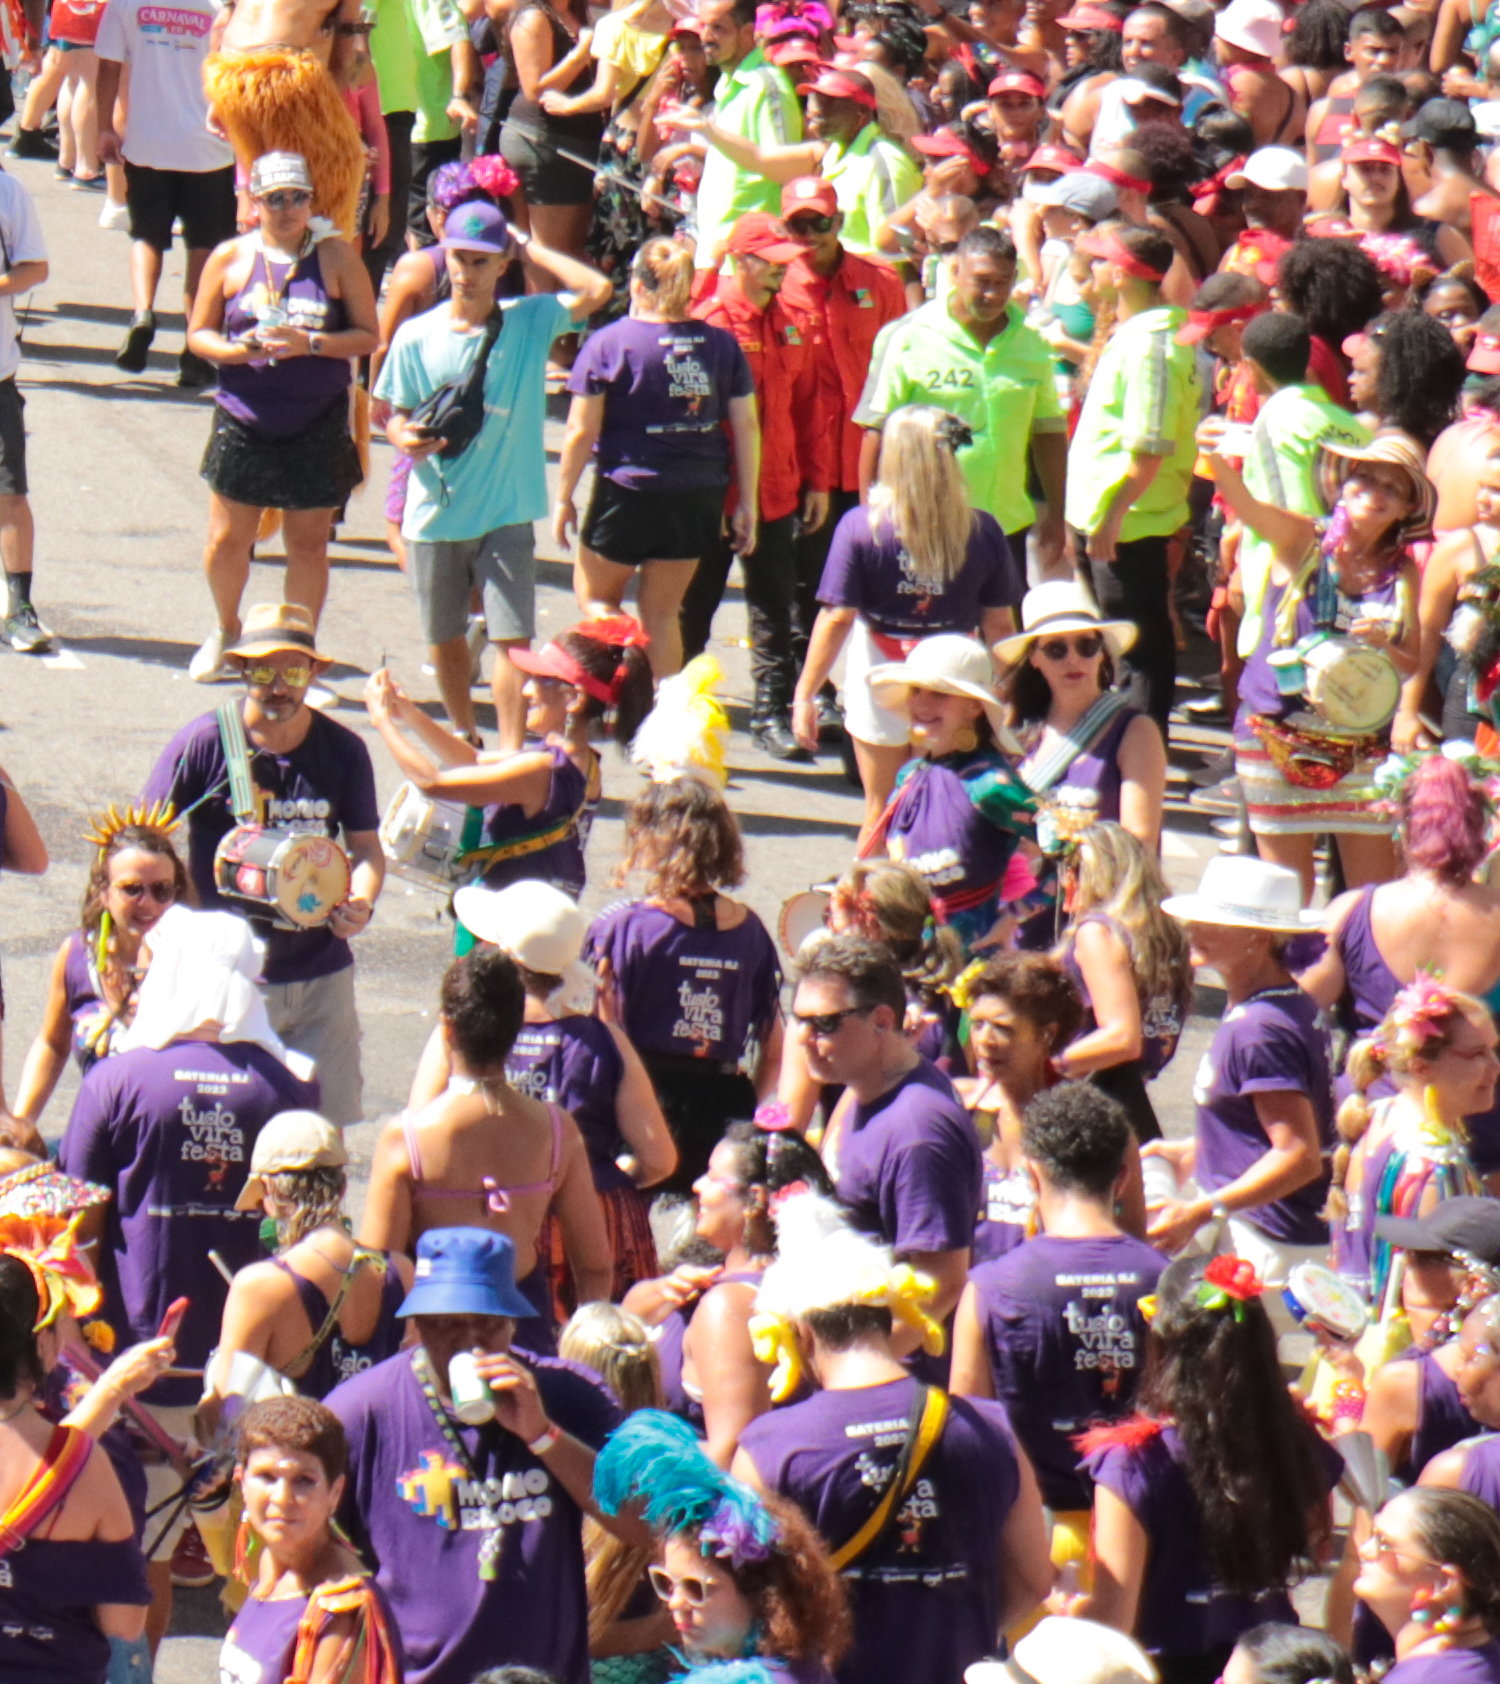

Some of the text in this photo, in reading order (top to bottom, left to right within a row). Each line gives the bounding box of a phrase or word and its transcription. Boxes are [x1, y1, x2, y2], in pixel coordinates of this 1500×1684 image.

[141, 9, 206, 29] CARNAVAL
[927, 369, 976, 389] 242
[269, 798, 331, 820] MONO
[678, 981, 718, 1009] tudo
[684, 1000, 723, 1025] vira
[672, 1020, 722, 1041] festa
[174, 1071, 250, 1084] BATERIA RJ
[197, 1083, 228, 1095] 2023
[178, 1096, 235, 1128] tudo
[190, 1120, 245, 1145] vira
[181, 1140, 245, 1162] festa
[1055, 1273, 1137, 1287] BATERIA RJ
[1082, 1287, 1115, 1300] 2023
[1062, 1300, 1124, 1334] tudo
[1080, 1326, 1135, 1351] vira
[1074, 1347, 1136, 1371] festa
[457, 1468, 549, 1506] MONO
